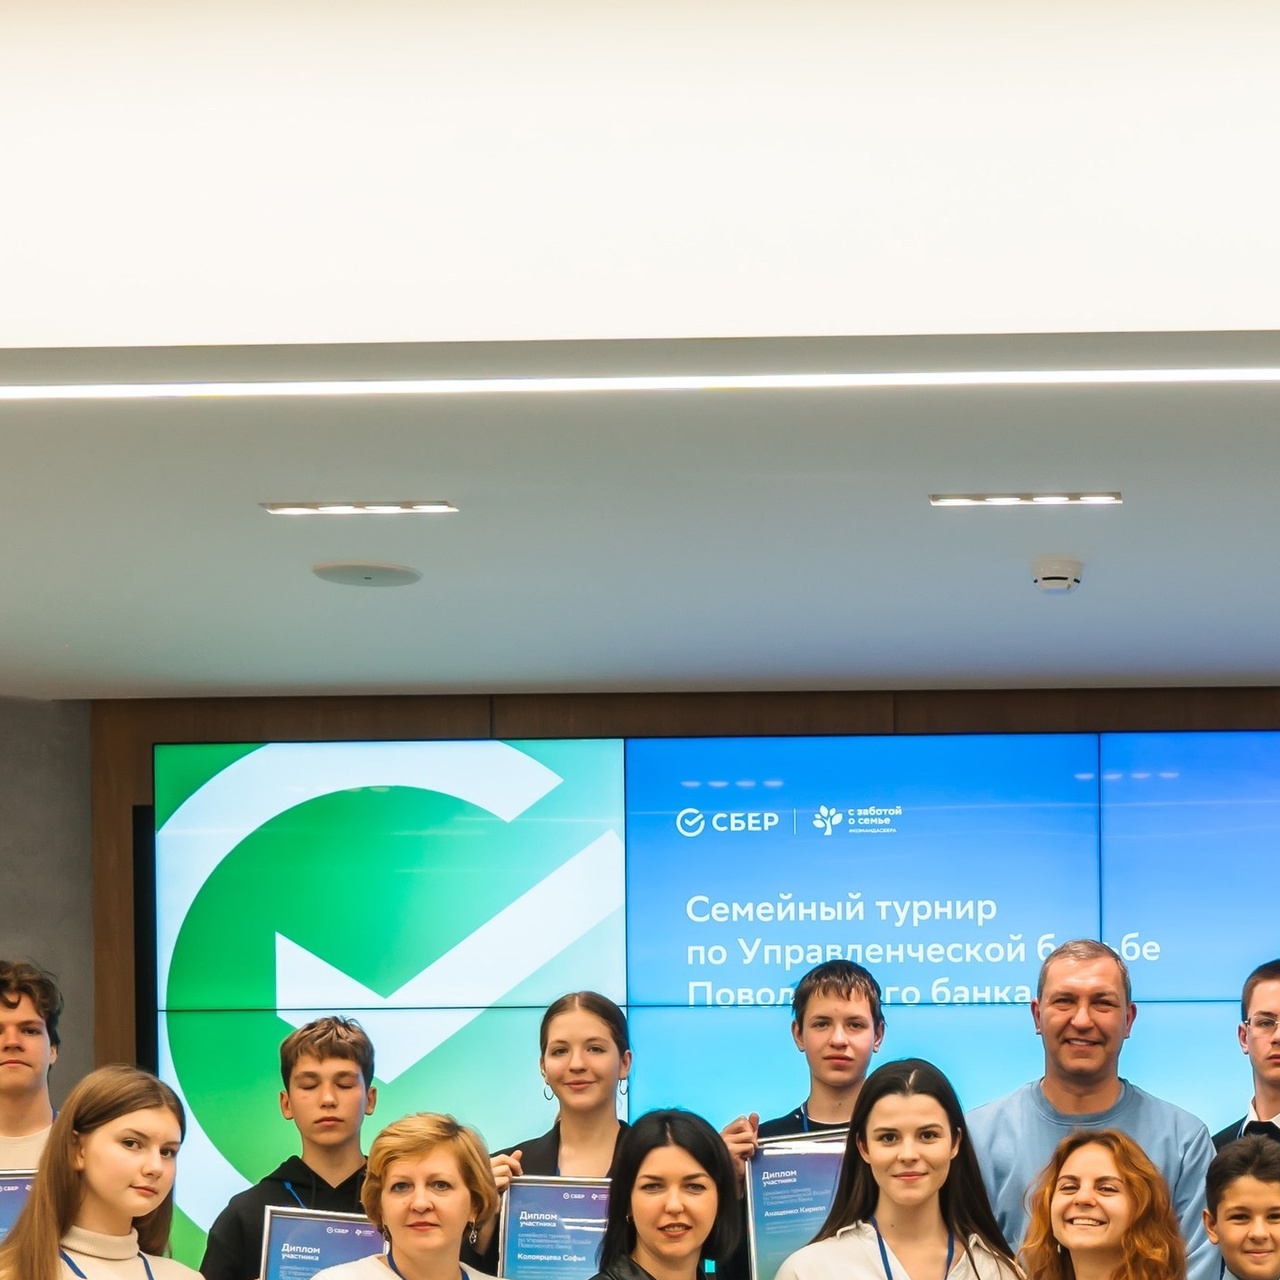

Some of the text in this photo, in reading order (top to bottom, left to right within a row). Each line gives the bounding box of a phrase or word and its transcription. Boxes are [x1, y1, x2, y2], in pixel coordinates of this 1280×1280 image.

[857, 805, 903, 816] заботой
[712, 812, 779, 832] СБЕР
[848, 817, 891, 825] о семье
[686, 892, 997, 927] Семейный турнир
[687, 931, 1161, 971] по Управленческой ббе
[688, 976, 1031, 1009] Поволго банка
[762, 1170, 797, 1180] Диплом
[519, 1211, 557, 1220] Диплом
[281, 1243, 320, 1253] Диплом
[282, 1253, 319, 1261] участника
